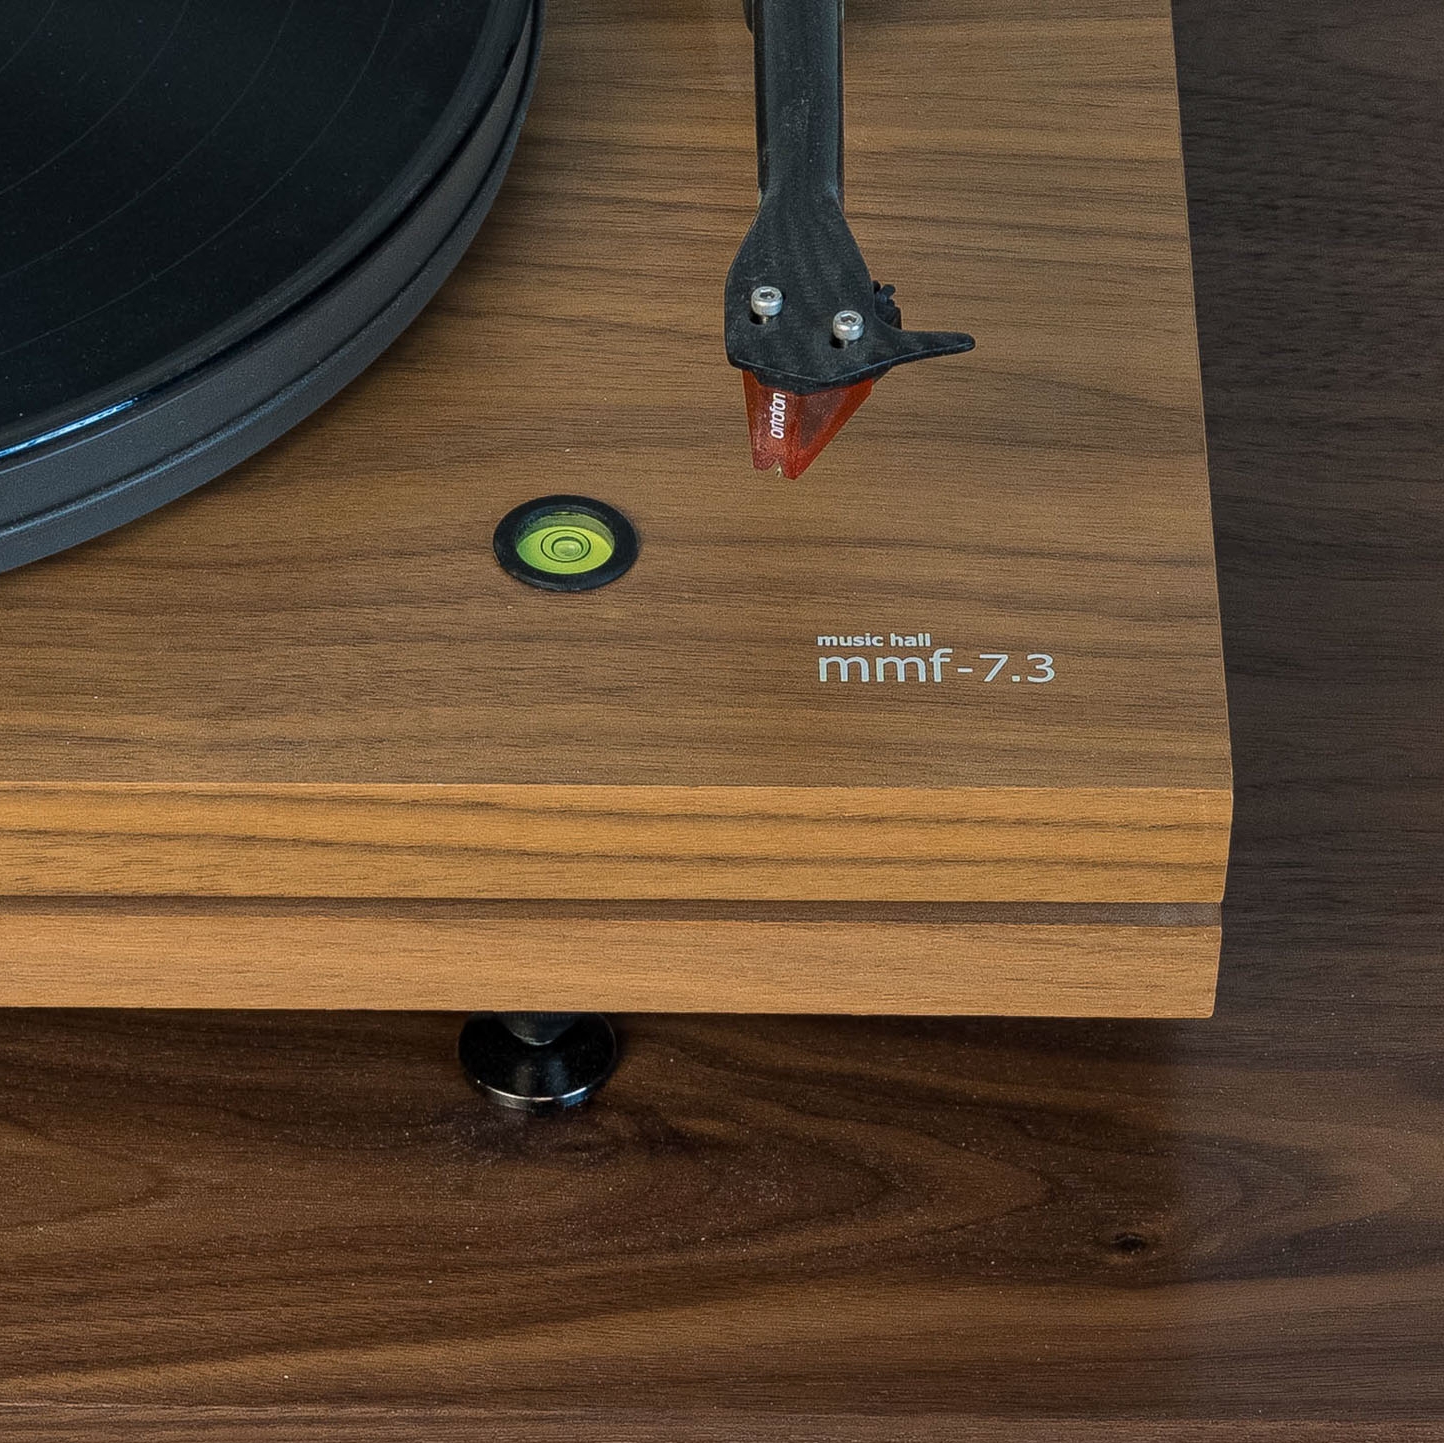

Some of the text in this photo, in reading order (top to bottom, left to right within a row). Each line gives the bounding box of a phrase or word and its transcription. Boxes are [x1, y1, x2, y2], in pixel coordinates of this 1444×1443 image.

[769, 392, 787, 440] ortofon
[816, 632, 931, 648] music hall
[818, 647, 1056, 683] mmf-7.3
